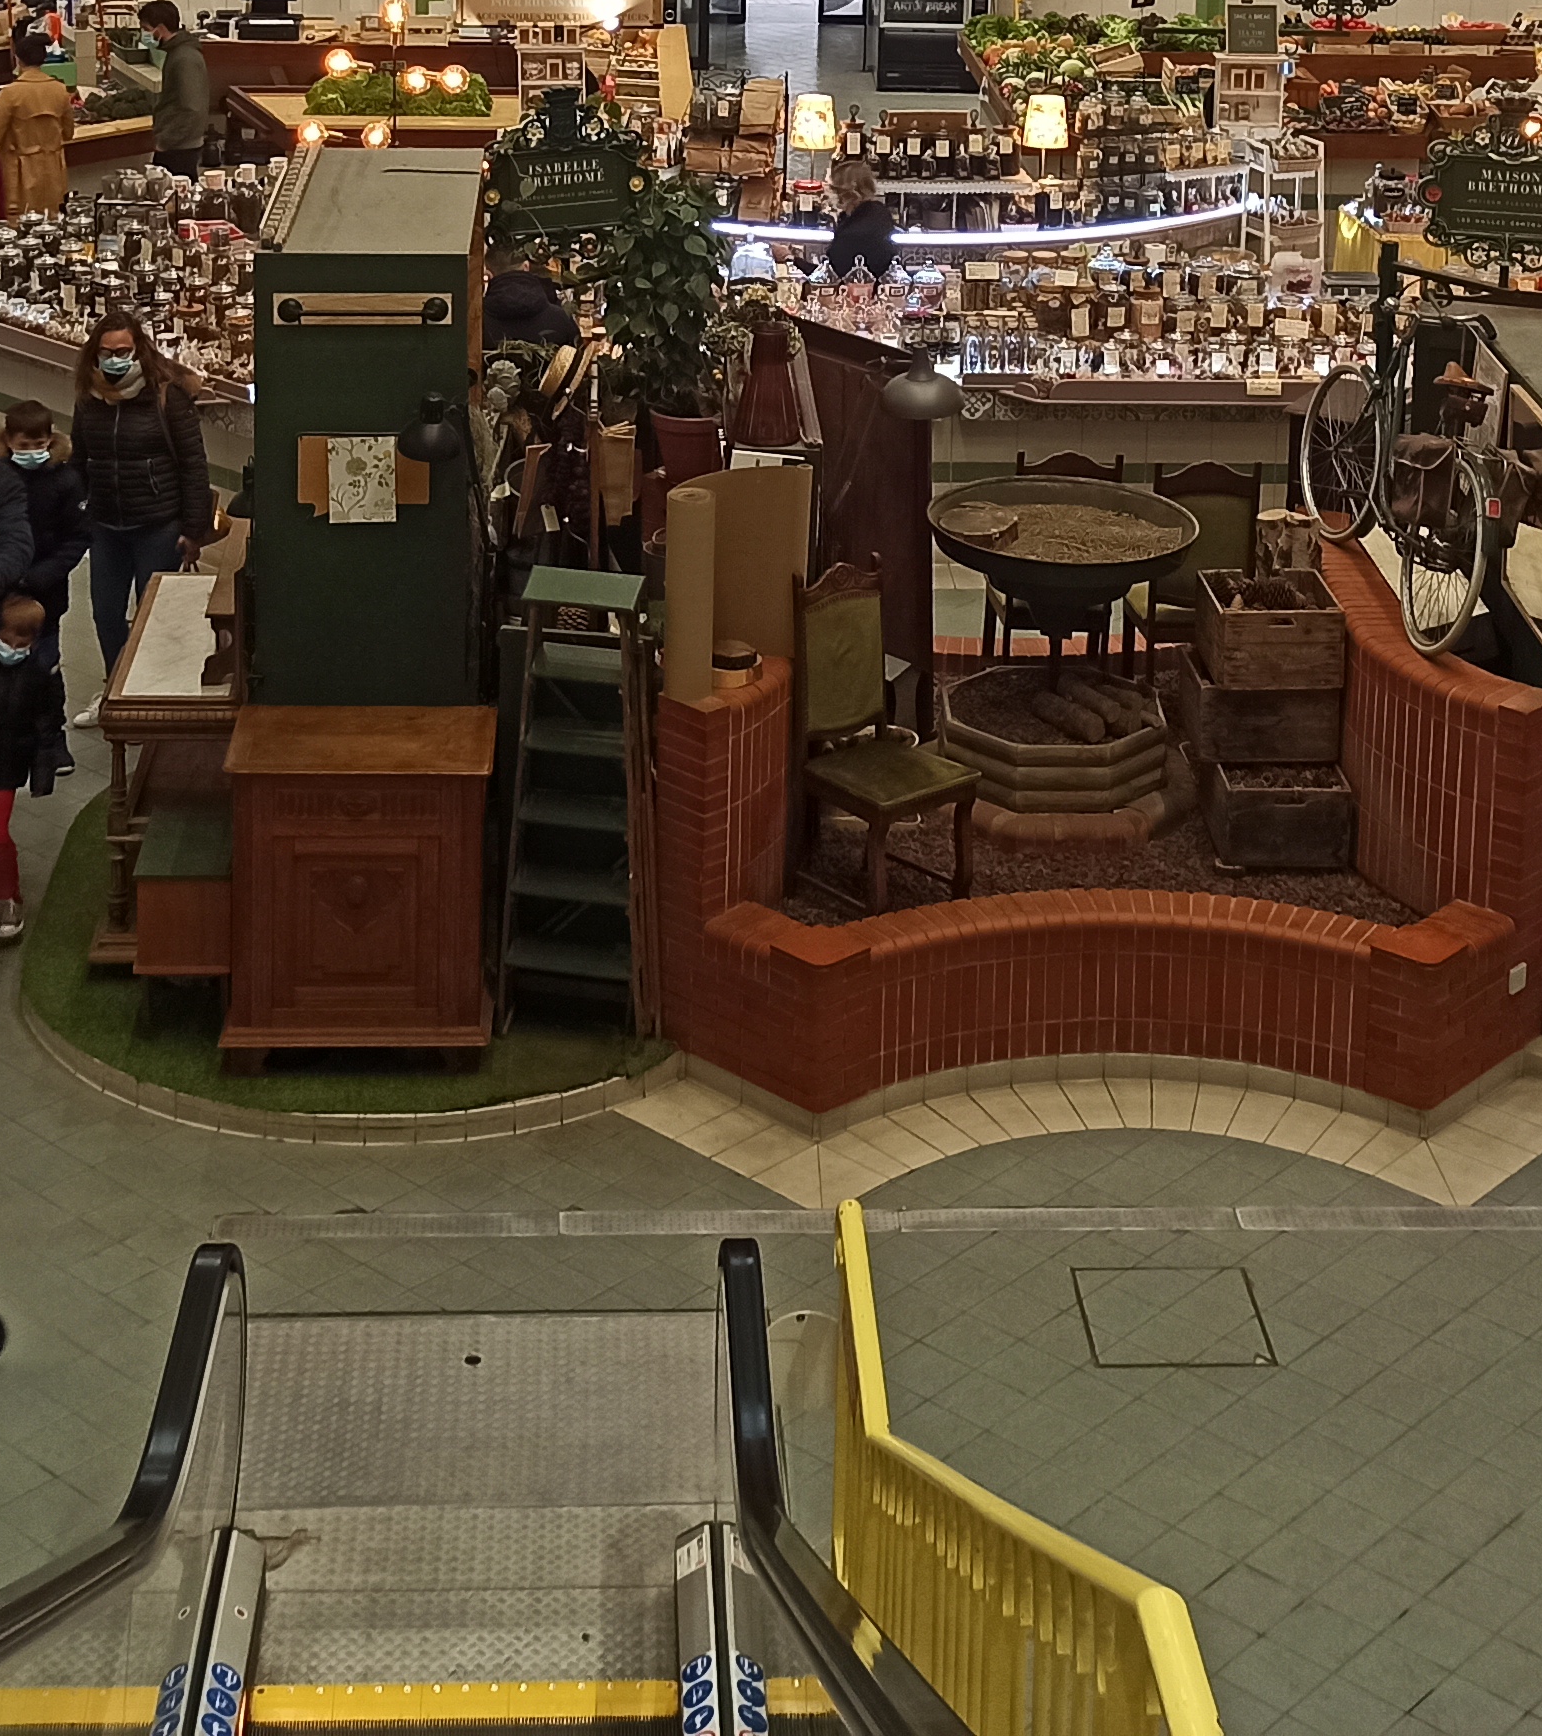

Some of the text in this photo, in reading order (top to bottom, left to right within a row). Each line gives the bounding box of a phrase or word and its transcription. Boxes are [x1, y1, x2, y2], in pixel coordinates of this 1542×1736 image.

[528, 159, 600, 176] ISABELLE
[1480, 168, 1541, 183] MAISON
[533, 167, 605, 188] RETHOMÉ
